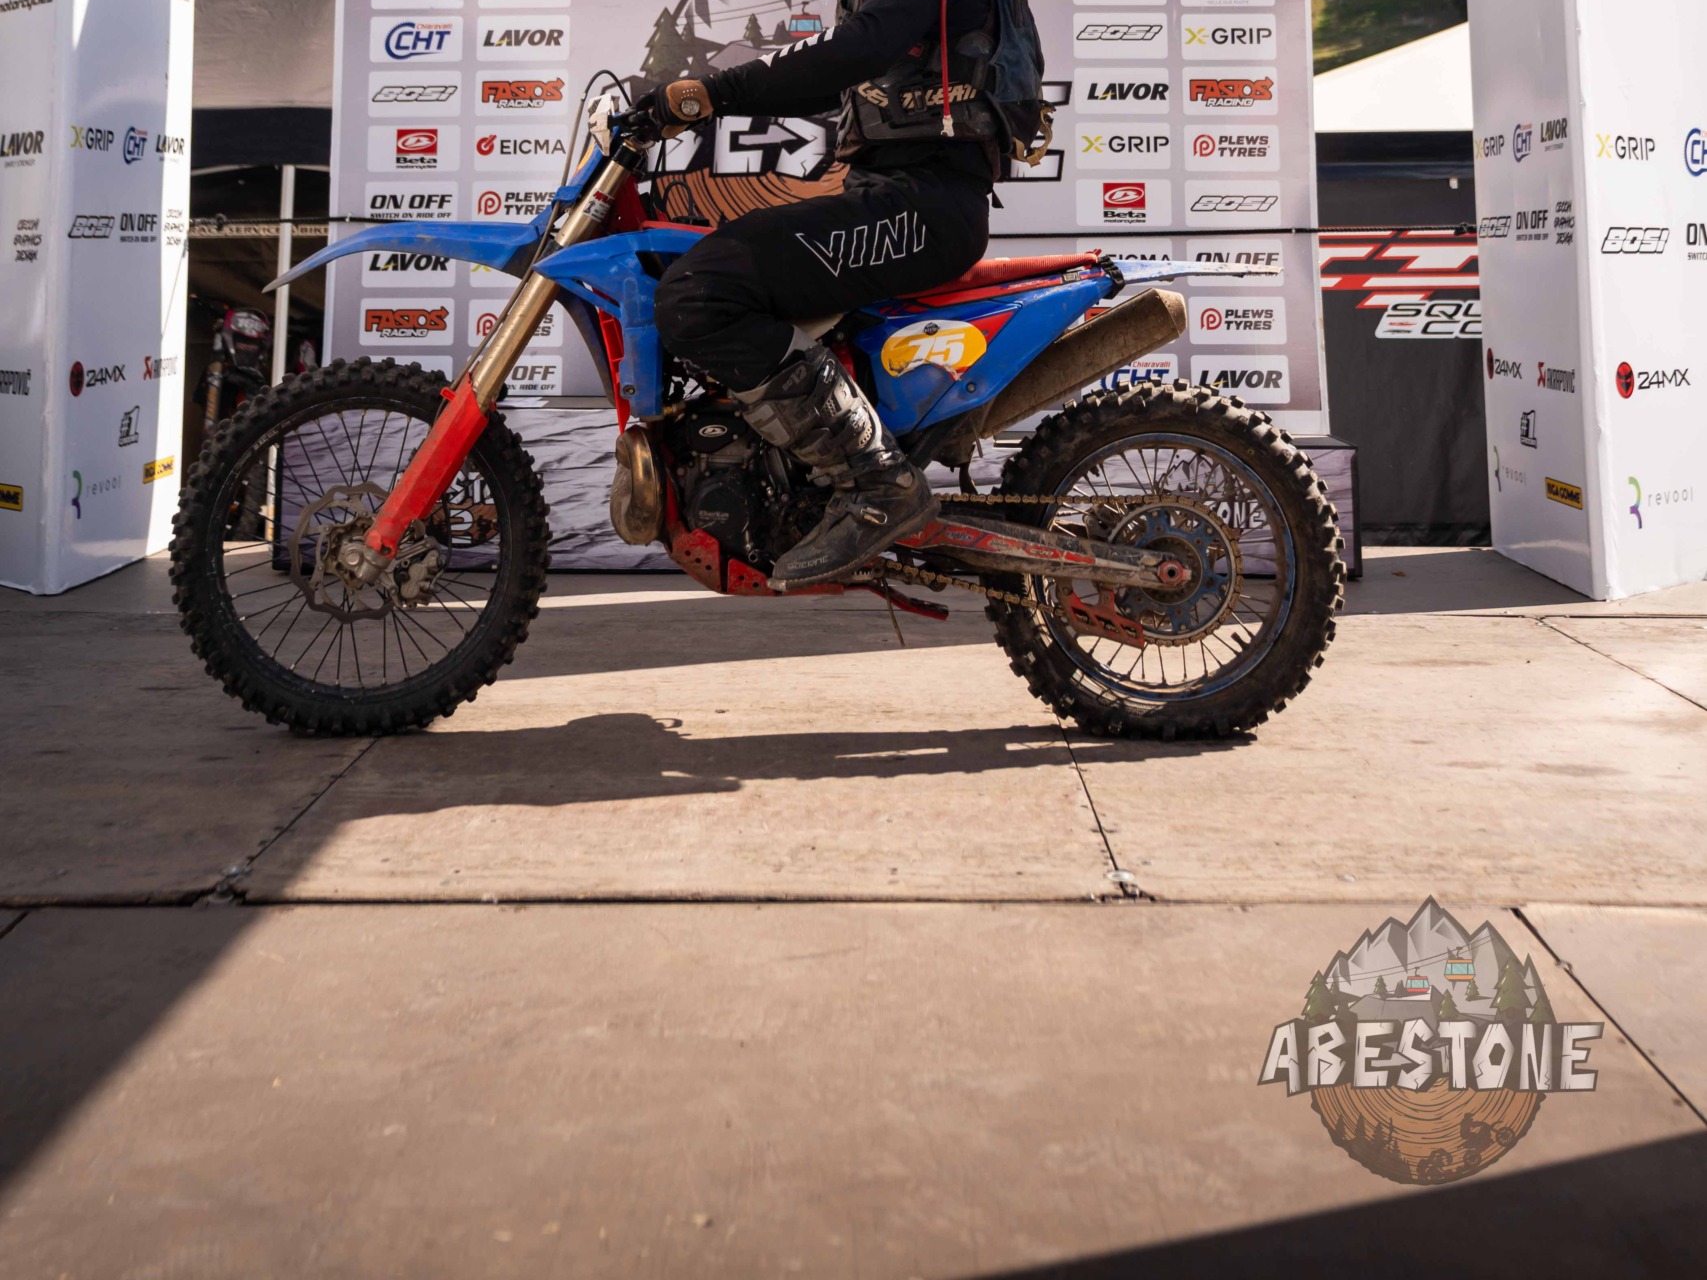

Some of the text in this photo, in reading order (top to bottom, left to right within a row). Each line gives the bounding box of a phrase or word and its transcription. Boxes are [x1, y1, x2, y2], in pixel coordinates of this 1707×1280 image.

[483, 29, 564, 47] LAVOR
[1076, 25, 1163, 40] BOSI
[1184, 27, 1272, 45] X-GRIP
[1087, 83, 1169, 100] LAVOR
[497, 98, 545, 108] RACING
[1206, 98, 1255, 107] RACING
[70, 125, 114, 151] X-GRIP
[1540, 118, 1567, 143] LAVOR
[0, 131, 44, 157] LAVOR
[500, 140, 566, 155] EICMA
[1081, 135, 1169, 153] X-GRIP
[1219, 135, 1269, 145] PLEWS
[1475, 134, 1505, 159] X-GRIP
[1595, 133, 1655, 160] X-GRIP
[396, 156, 437, 165] Beta
[1218, 147, 1267, 157] TYRES
[370, 194, 452, 209] ON OFF
[504, 204, 547, 215] TYRE
[1190, 196, 1278, 211] BOSI
[120, 213, 136, 231] ON
[137, 214, 157, 232] OFF
[1103, 210, 1146, 218] Beta
[1516, 210, 1548, 230] ON OFF
[1601, 227, 1669, 254] BOSI
[369, 254, 449, 271] LAVOR
[1225, 309, 1273, 319] PLEWS
[380, 328, 428, 338] RACING
[1224, 321, 1272, 330] TYRES
[908, 333, 966, 367] 75
[86, 365, 126, 388] 24MX
[511, 366, 556, 380] OFF
[1494, 358, 1522, 379] 24MX
[1200, 370, 1282, 389] LAVOR
[1637, 368, 1691, 390] 24MX
